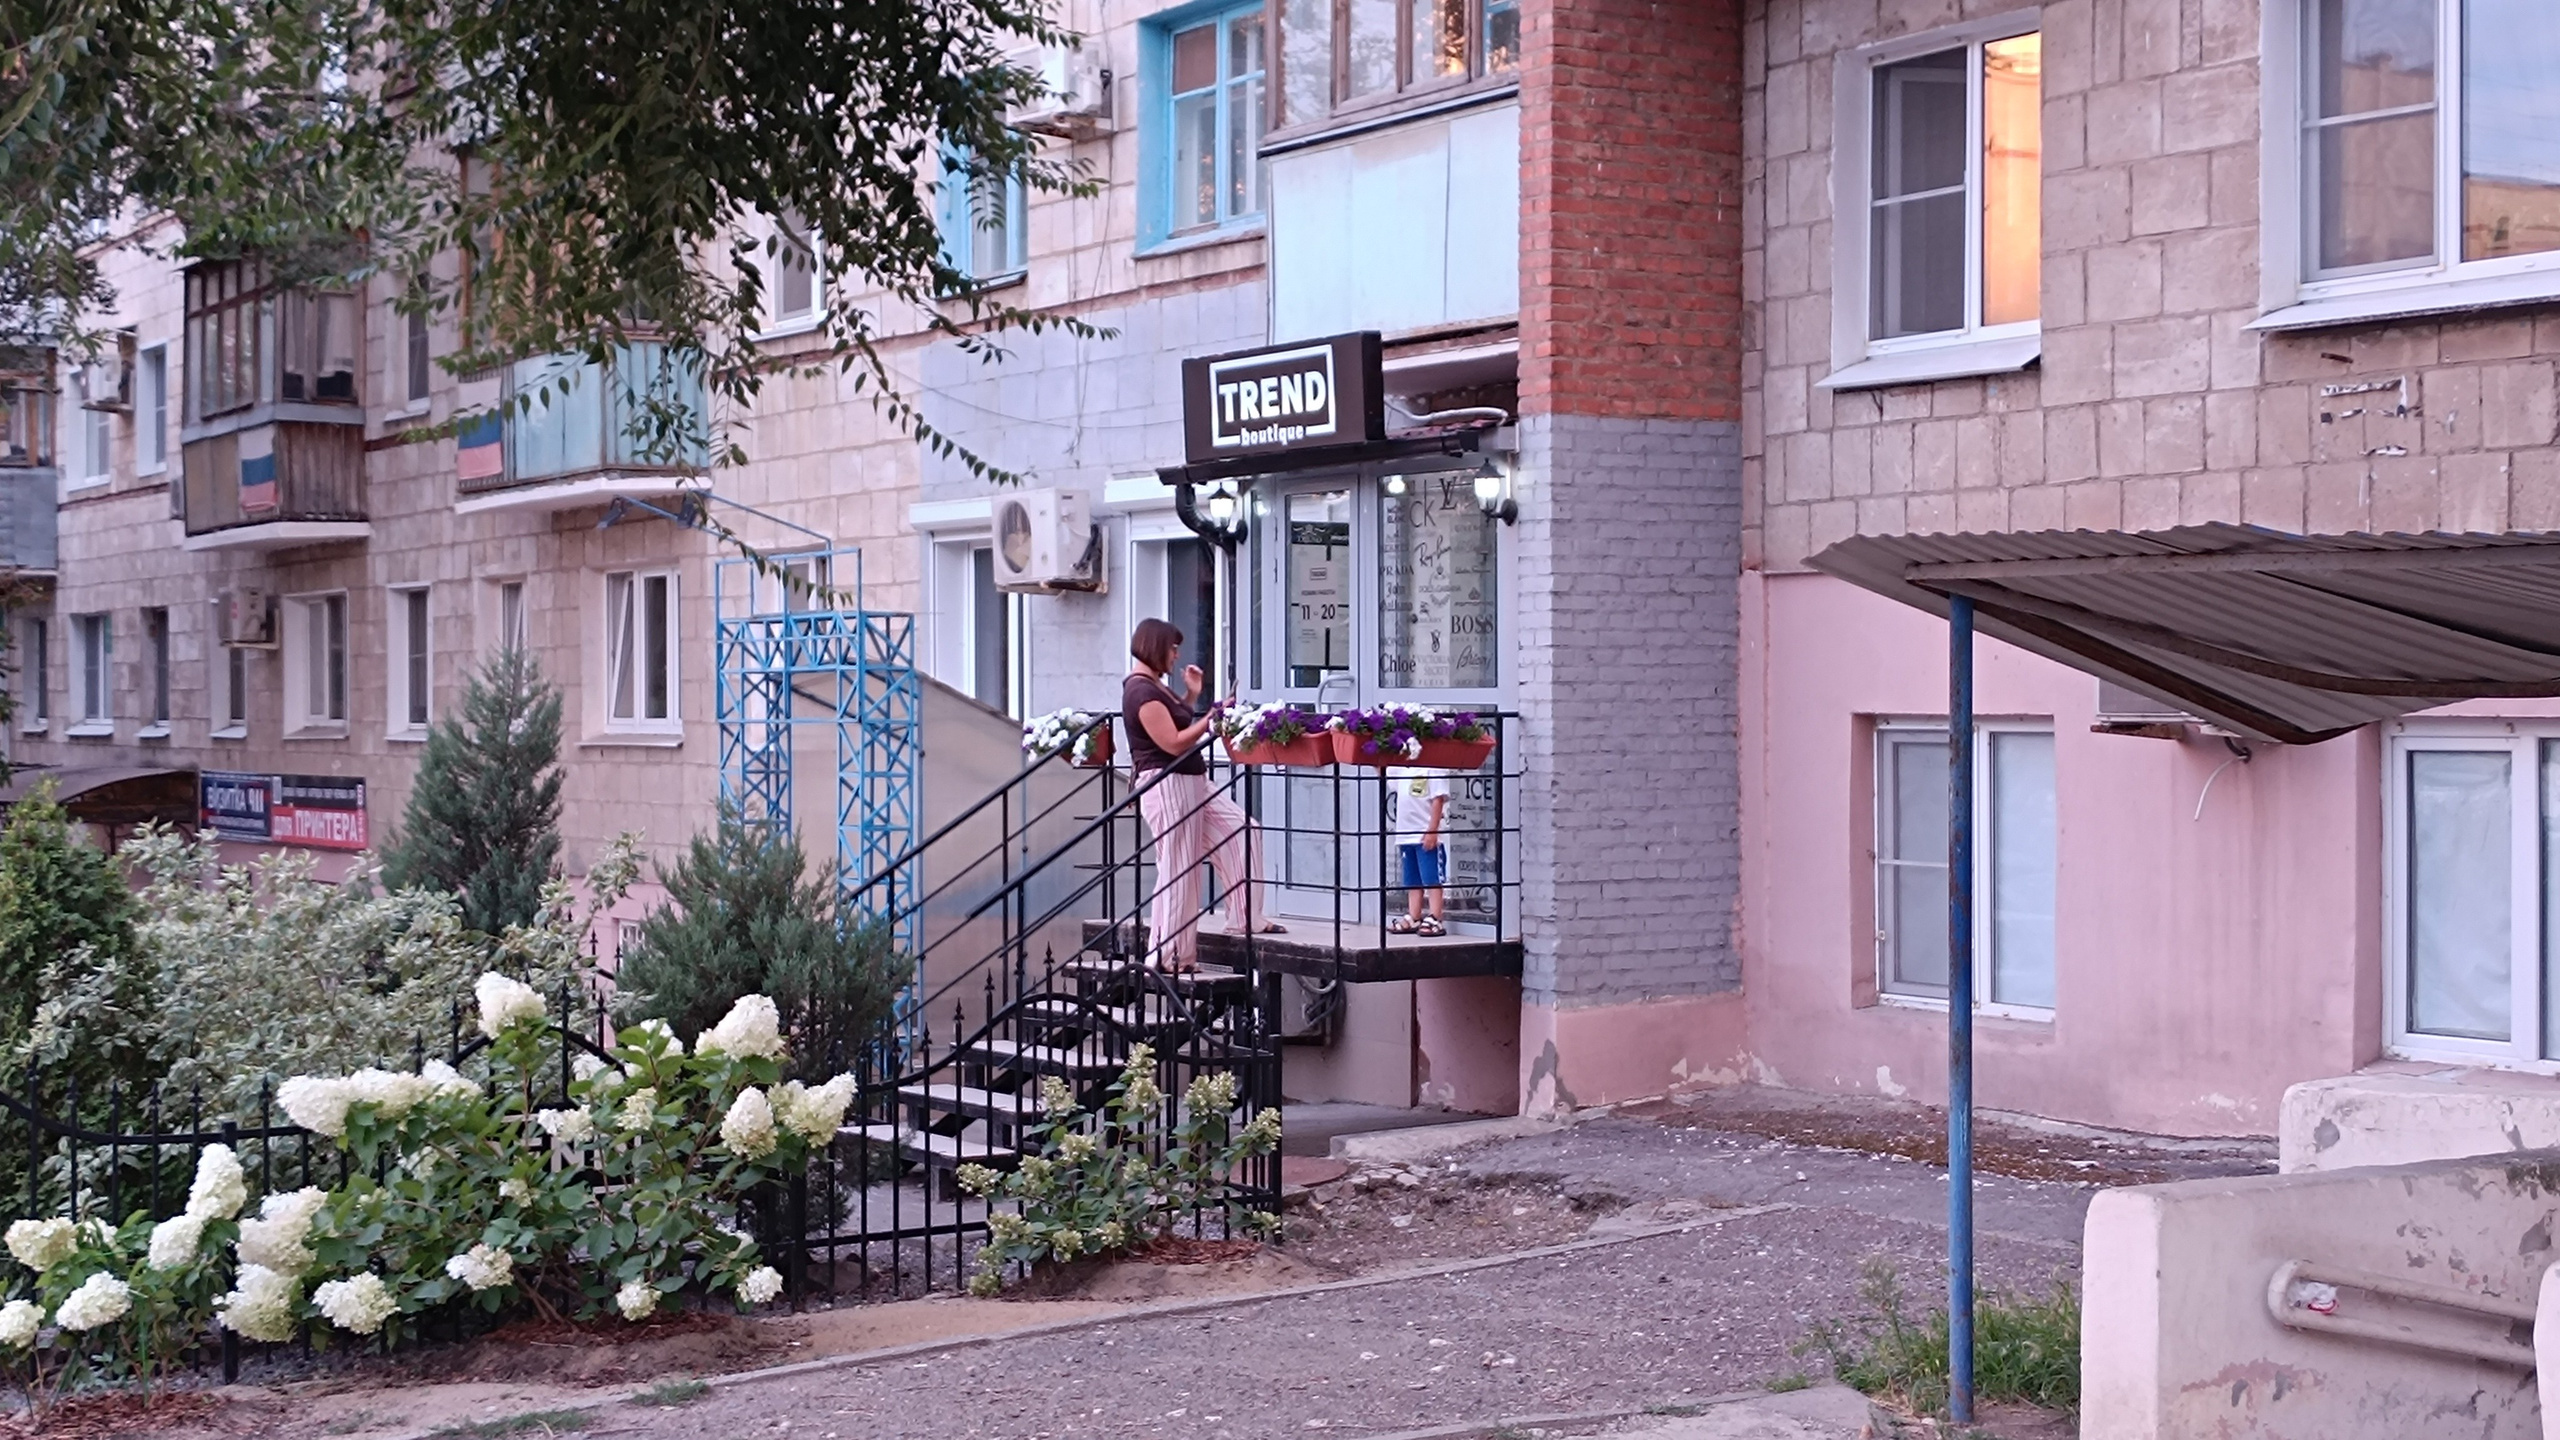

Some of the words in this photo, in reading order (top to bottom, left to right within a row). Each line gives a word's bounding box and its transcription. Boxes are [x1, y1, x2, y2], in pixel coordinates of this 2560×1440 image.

[1218, 370, 1327, 423] TREND
[1240, 423, 1305, 447] boutique
[1301, 604, 1310, 620] 11
[1321, 603, 1336, 620] 20
[1451, 614, 1494, 635] BOSS
[1379, 652, 1417, 673] Chloé
[294, 809, 359, 842] ПРИНТЕРА
